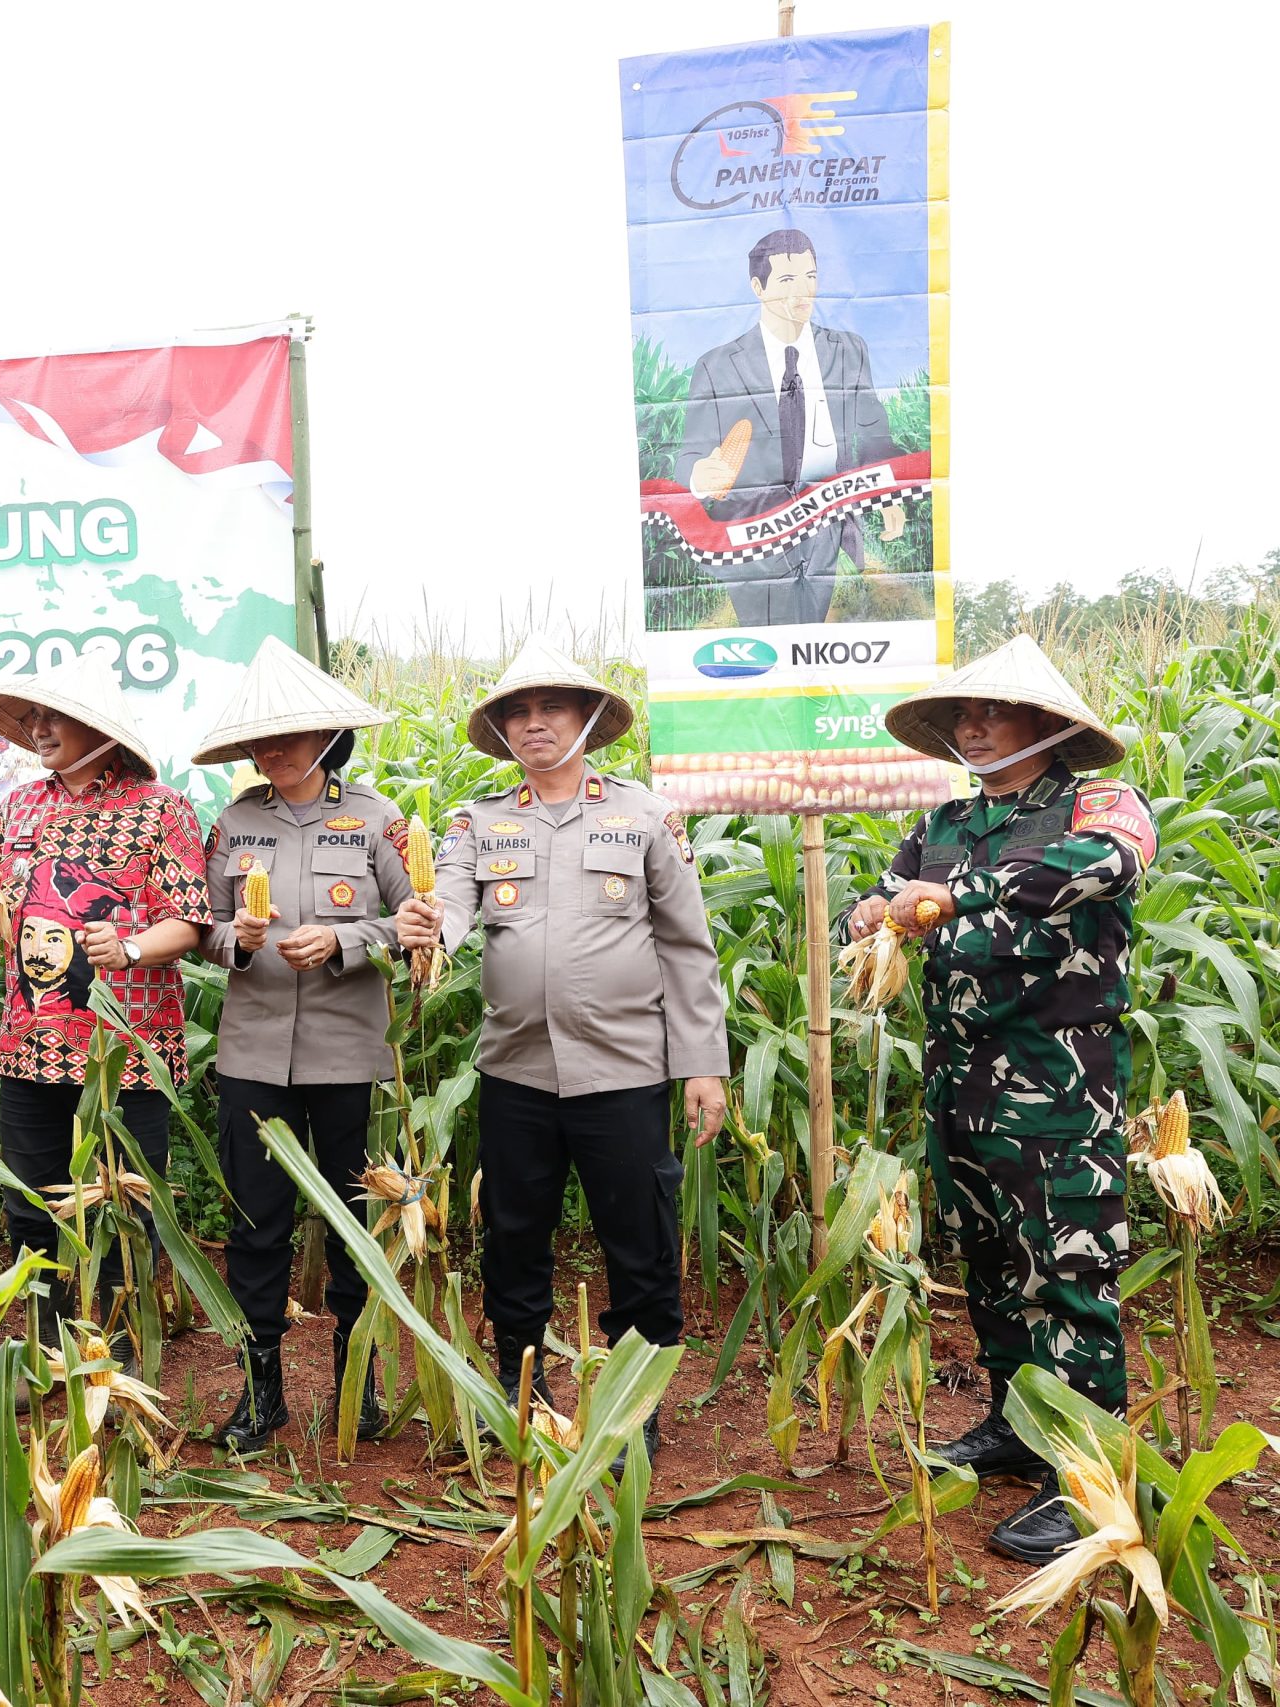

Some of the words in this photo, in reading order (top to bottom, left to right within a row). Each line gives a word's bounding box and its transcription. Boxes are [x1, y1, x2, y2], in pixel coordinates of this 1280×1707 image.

[727, 127, 770, 141] 105hst
[715, 159, 802, 187] PANEN
[808, 155, 886, 178] CEPAT
[825, 175, 878, 186] Bersama
[751, 189, 785, 209] NK
[790, 185, 880, 204] Andalan
[745, 497, 820, 541] PANEN
[820, 472, 883, 504] CEPAT
[713, 642, 761, 663] NK
[814, 713, 886, 741] synge
[229, 835, 257, 849] DAYU
[257, 836, 278, 848] ARI
[317, 834, 366, 847] POLRI
[480, 840, 493, 852] AL
[496, 838, 531, 851] HABSI
[588, 832, 642, 847] POLRI
